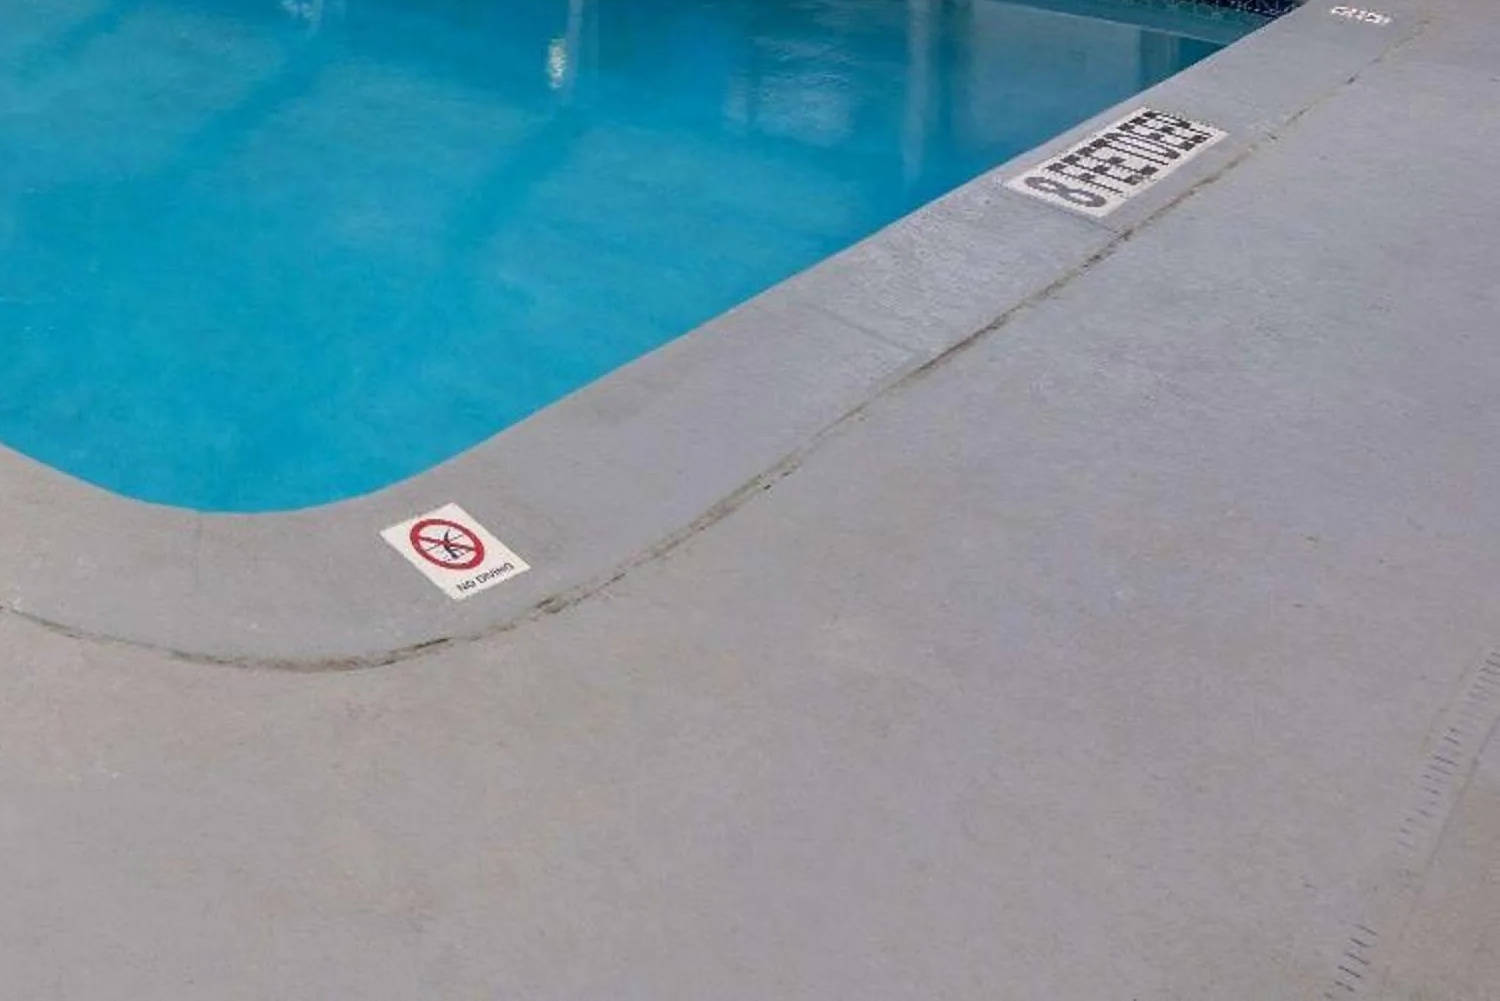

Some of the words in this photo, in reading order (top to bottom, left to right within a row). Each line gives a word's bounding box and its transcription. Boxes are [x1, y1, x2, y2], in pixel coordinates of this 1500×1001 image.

[1046, 138, 1169, 194] FEET
[1024, 176, 1107, 208] 8
[456, 579, 477, 592] NO
[475, 562, 515, 584] DIVING
